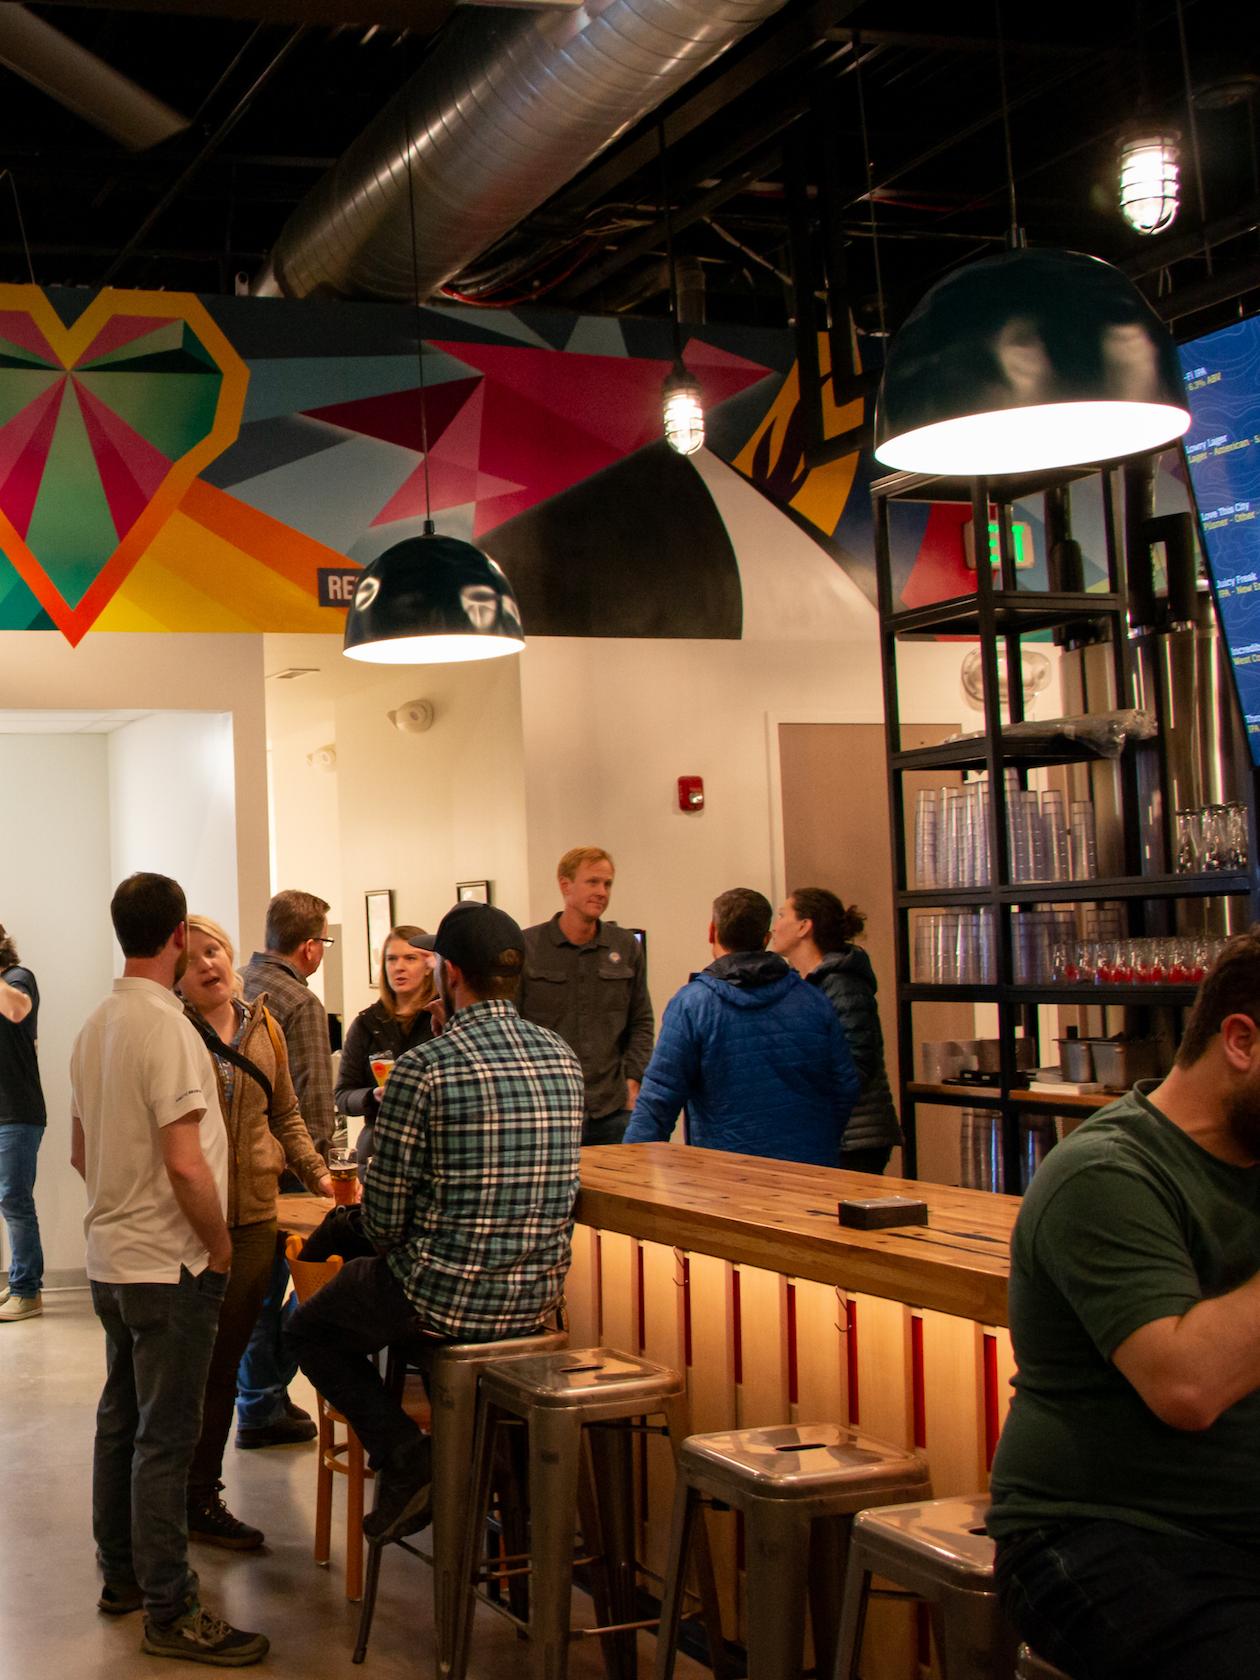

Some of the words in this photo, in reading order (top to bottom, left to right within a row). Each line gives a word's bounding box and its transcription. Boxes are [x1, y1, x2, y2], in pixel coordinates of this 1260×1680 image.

[1207, 372, 1221, 384] ABV
[1185, 441, 1207, 454] Lowry
[1207, 434, 1228, 447] Lager
[1188, 452, 1208, 464] Lager
[1214, 439, 1250, 456] American
[1201, 511, 1218, 521] Love
[1218, 506, 1235, 516] This
[1235, 502, 1250, 512] City
[1204, 519, 1228, 531] Pilsner
[1235, 512, 1255, 522] Other
[1216, 578, 1236, 589] Juicy
[1236, 572, 1258, 584] Freak
[1218, 589, 1231, 599] IPA
[1236, 585, 1253, 595] New
